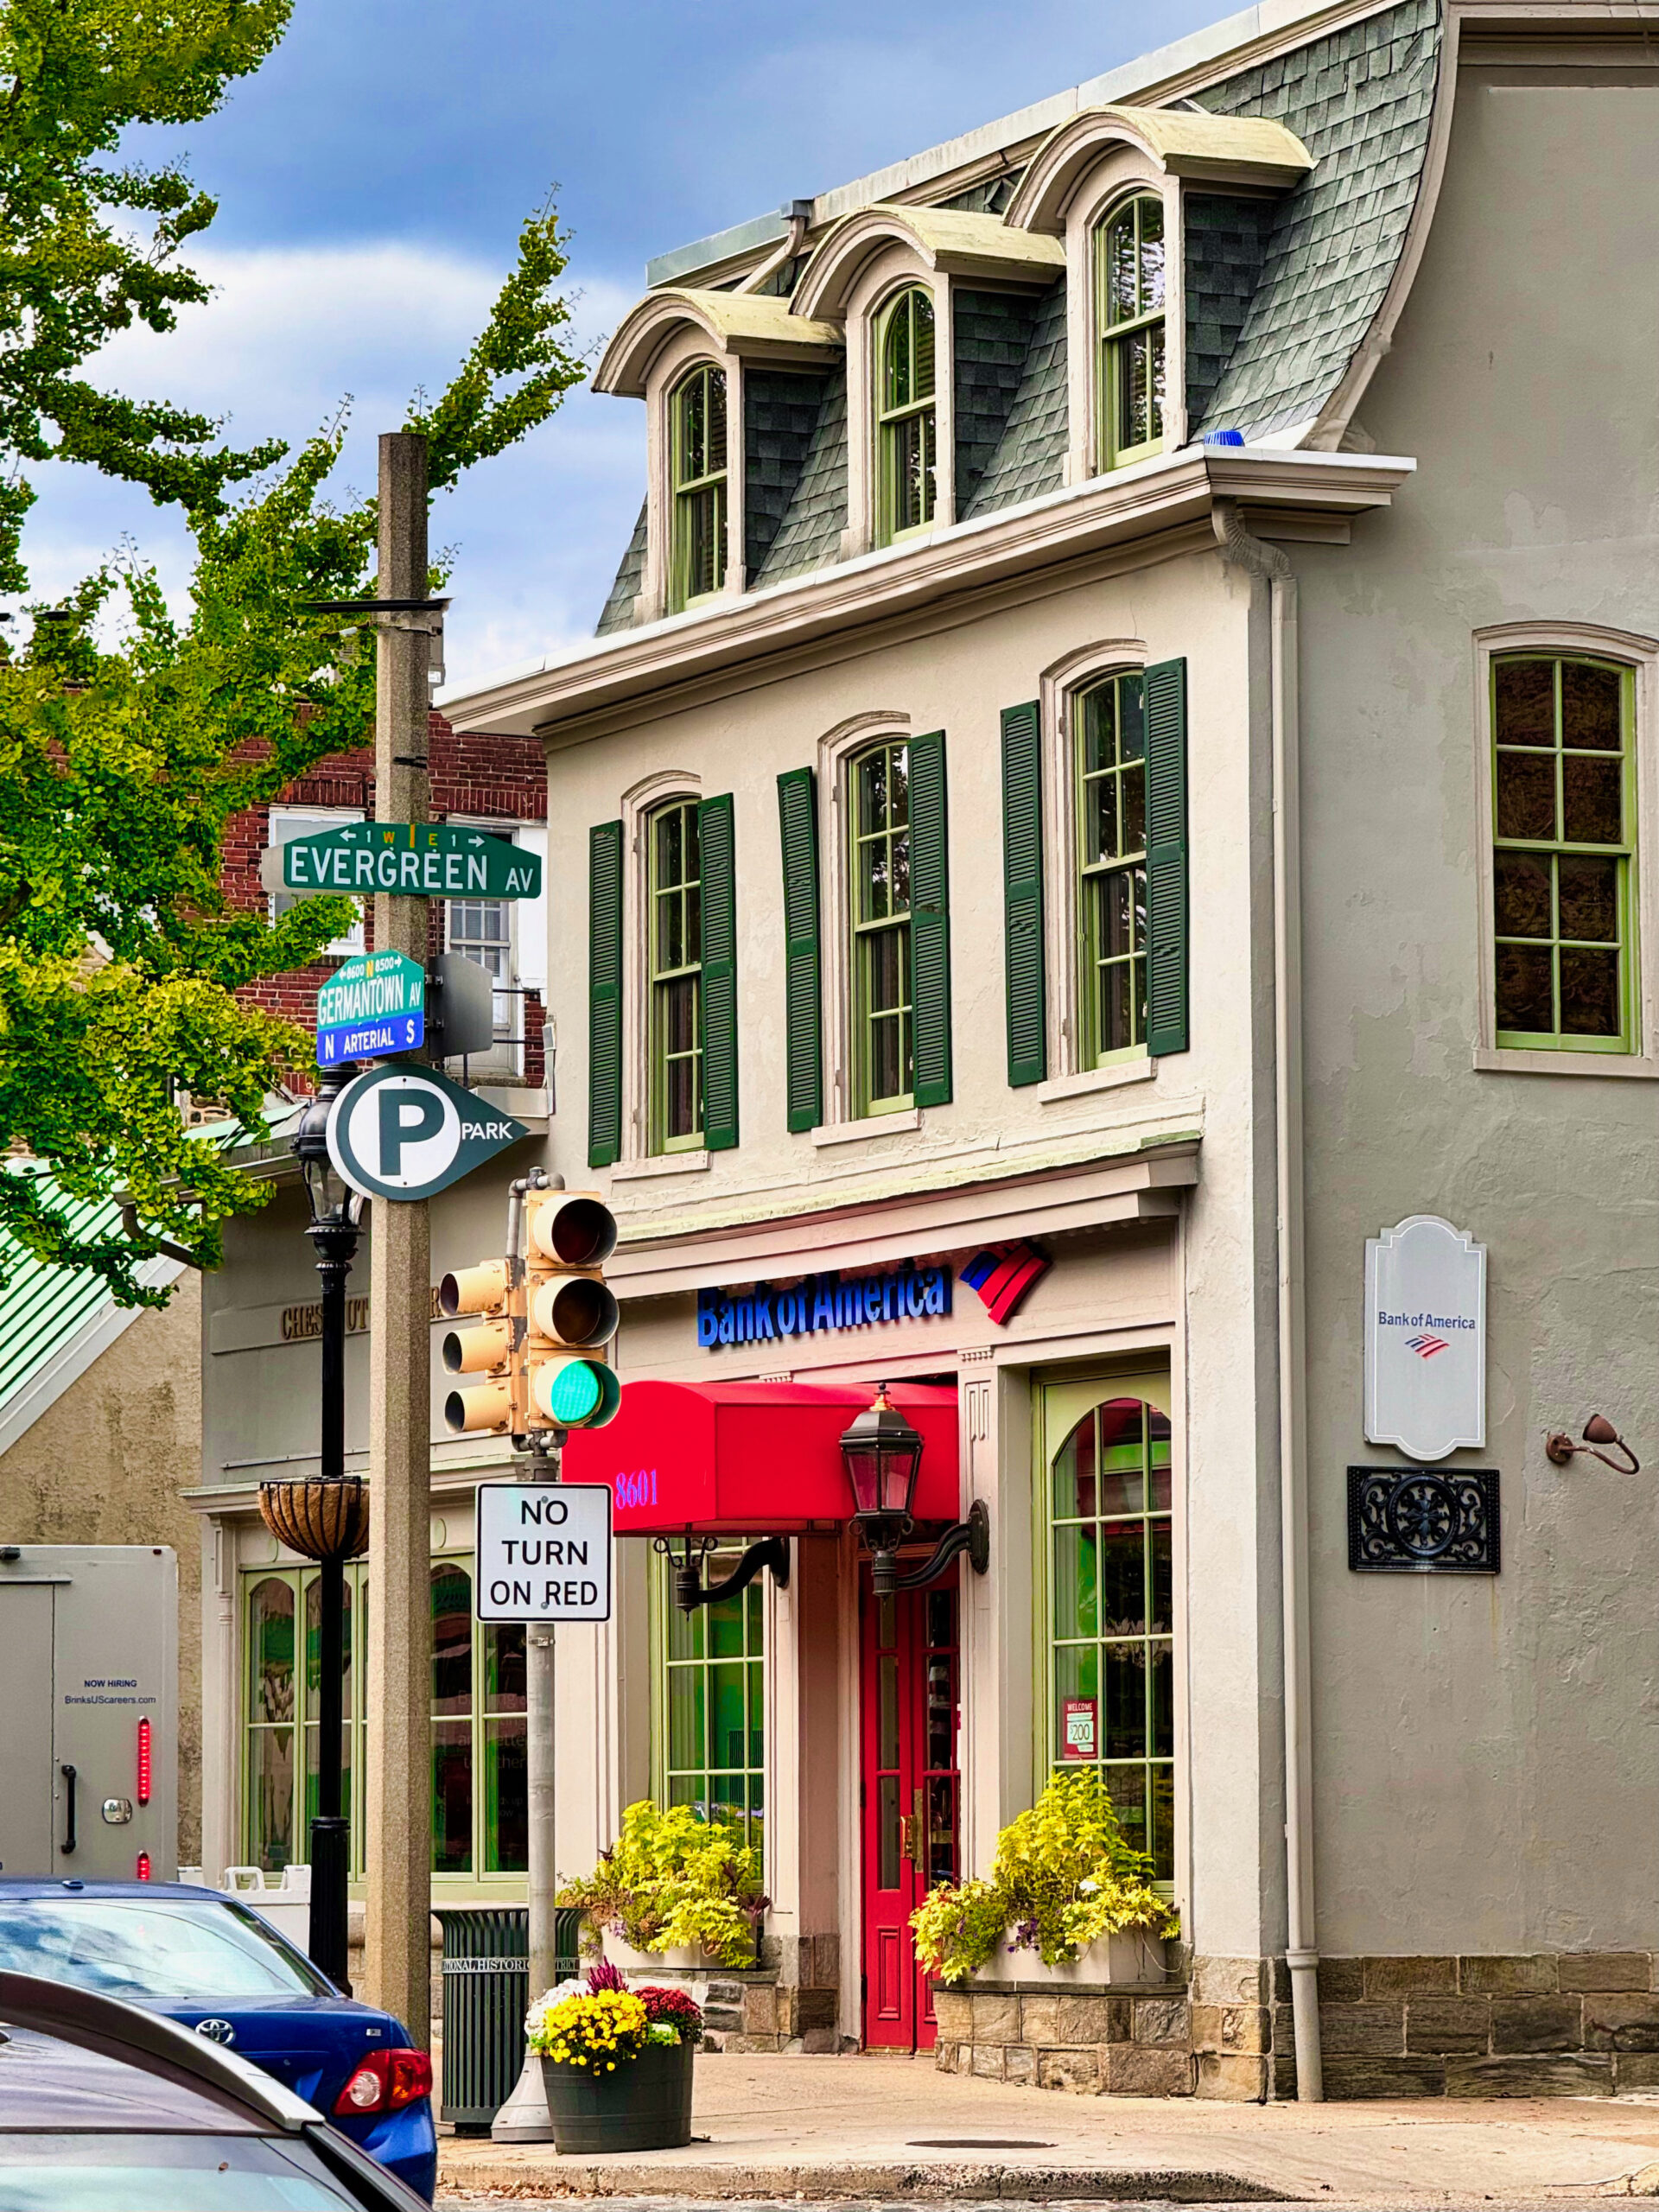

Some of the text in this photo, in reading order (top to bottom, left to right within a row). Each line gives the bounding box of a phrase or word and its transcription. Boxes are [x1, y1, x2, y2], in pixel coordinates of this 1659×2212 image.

[366, 830, 456, 847] 1 W E 1
[290, 846, 533, 892] EVERGREEN AV
[346, 957, 394, 980] 8600 N 8500
[318, 973, 422, 1026] GERMANTOWN AV
[325, 1019, 415, 1059] N ARTERIAL S
[378, 1089, 513, 1176] P PARK
[697, 1263, 947, 1347] Bank of America
[281, 1297, 369, 1340] CHESUT
[1378, 1312, 1476, 1329] Bank of America
[616, 1468, 658, 1510] 8601
[521, 1500, 569, 1525] NO
[501, 1541, 588, 1566] TURN
[490, 1580, 598, 1605] ON RED
[65, 1695, 156, 1704] BrinksUScareers.com
[1067, 1702, 1093, 1711] WELCOME
[478, 1959, 530, 1971] HISTORI
[556, 1960, 576, 1971] TRICT
